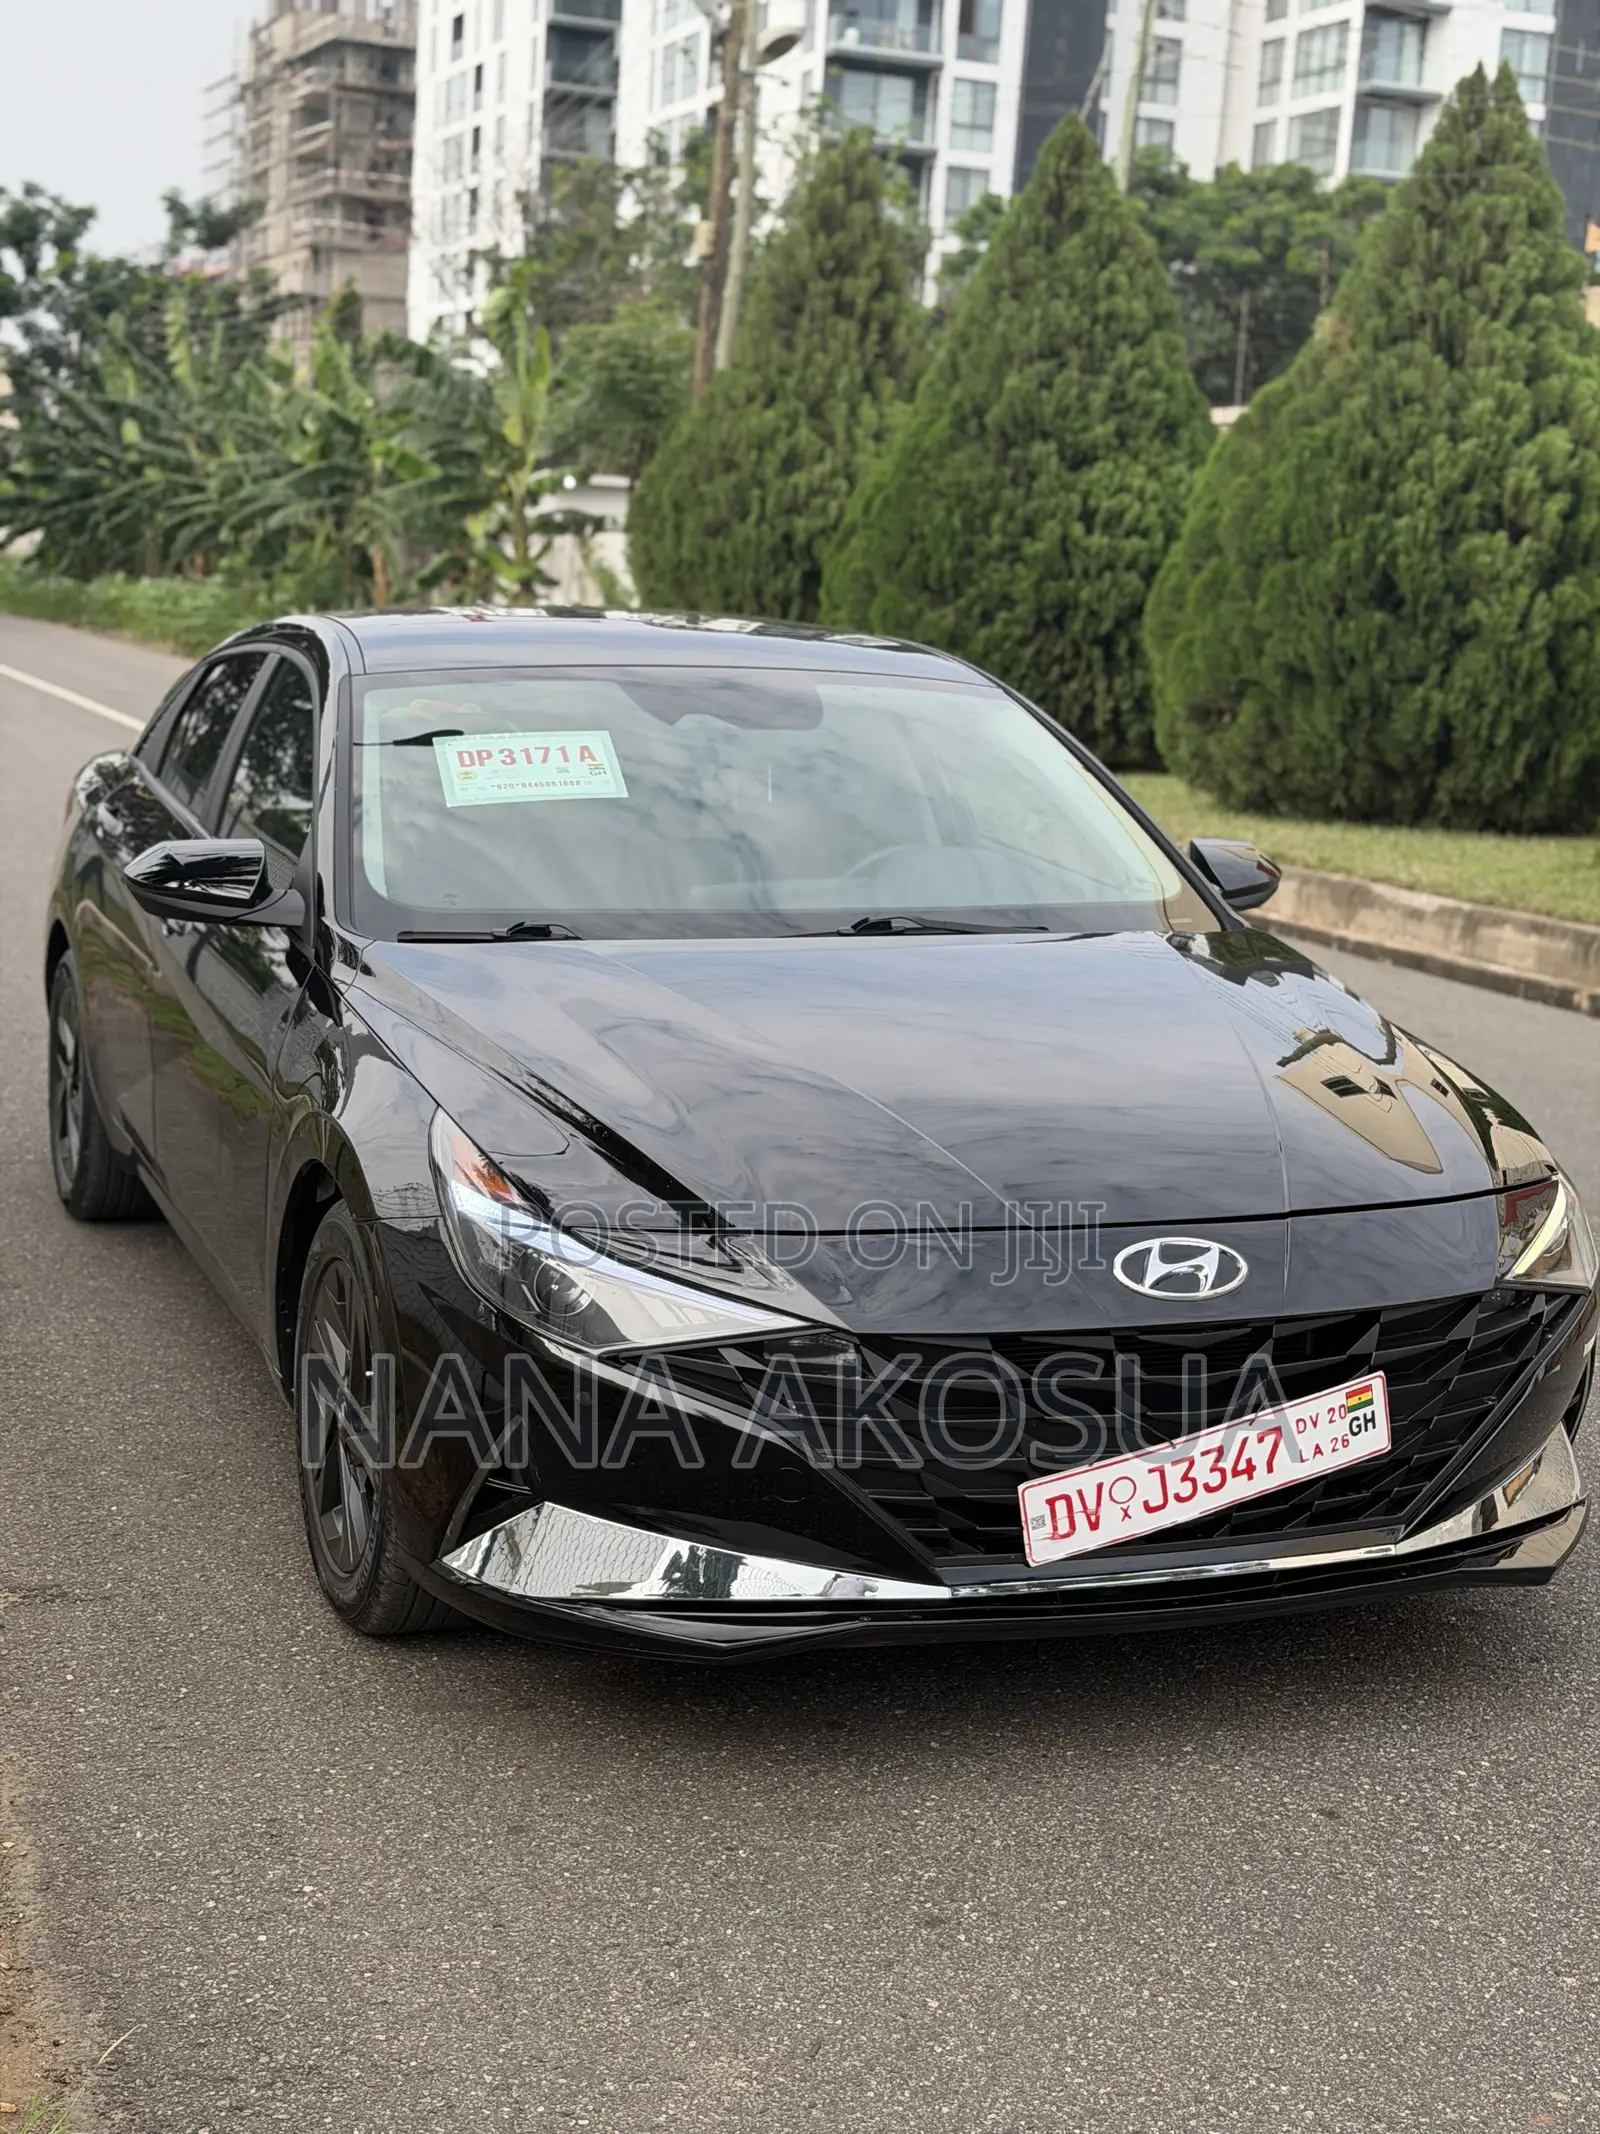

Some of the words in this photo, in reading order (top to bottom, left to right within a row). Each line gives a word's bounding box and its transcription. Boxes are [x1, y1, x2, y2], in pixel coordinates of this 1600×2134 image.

[456, 749, 493, 768] DP
[498, 745, 571, 766] 3171
[579, 745, 598, 763] A
[1295, 1412, 1320, 1434] DV
[1327, 1403, 1347, 1425] 20
[1348, 1410, 1377, 1437] GH
[1299, 1442, 1324, 1463] LA
[1330, 1433, 1350, 1453] 26
[1045, 1481, 1104, 1541] DV
[1142, 1425, 1283, 1514] J3347
